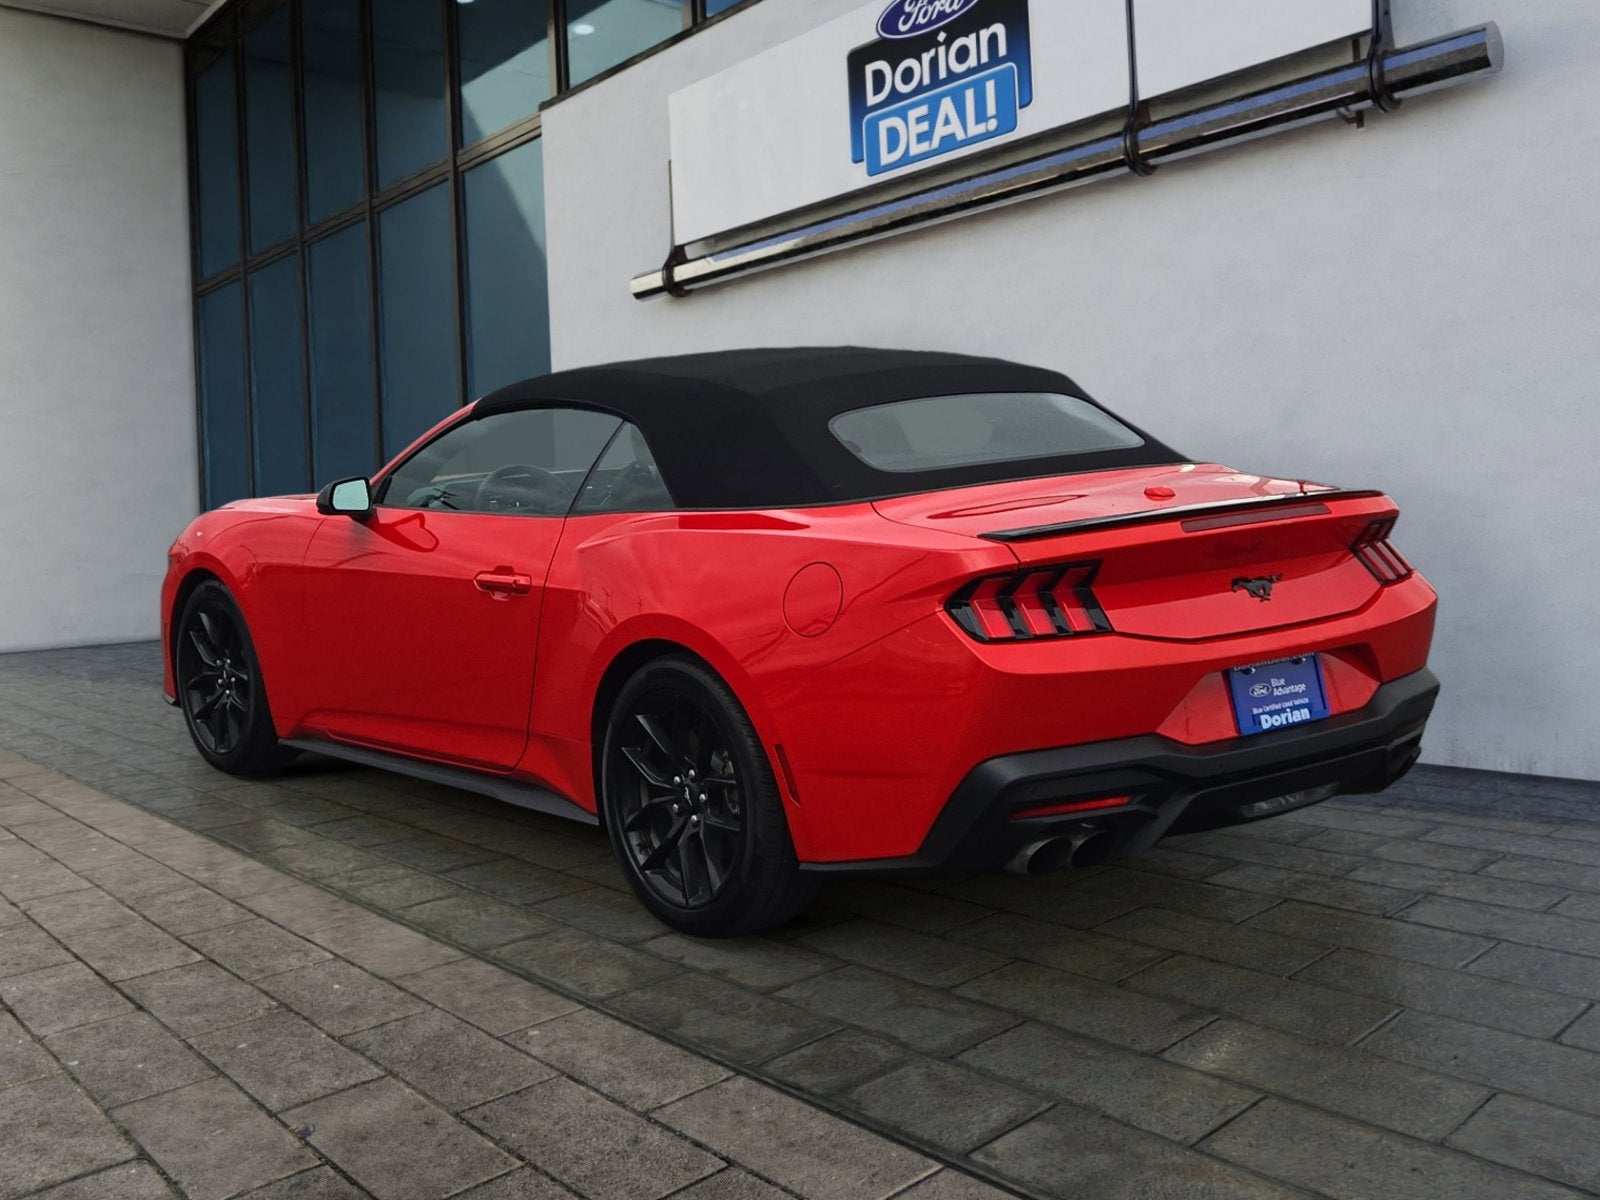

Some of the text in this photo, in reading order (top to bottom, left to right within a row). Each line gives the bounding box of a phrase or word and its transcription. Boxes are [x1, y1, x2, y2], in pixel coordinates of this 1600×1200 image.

[865, 22, 1007, 107] Dorian
[878, 79, 998, 167] DEAL!
[1271, 678, 1286, 687] Blue
[1273, 683, 1307, 696] Advantage
[1260, 708, 1311, 729] Dorian
